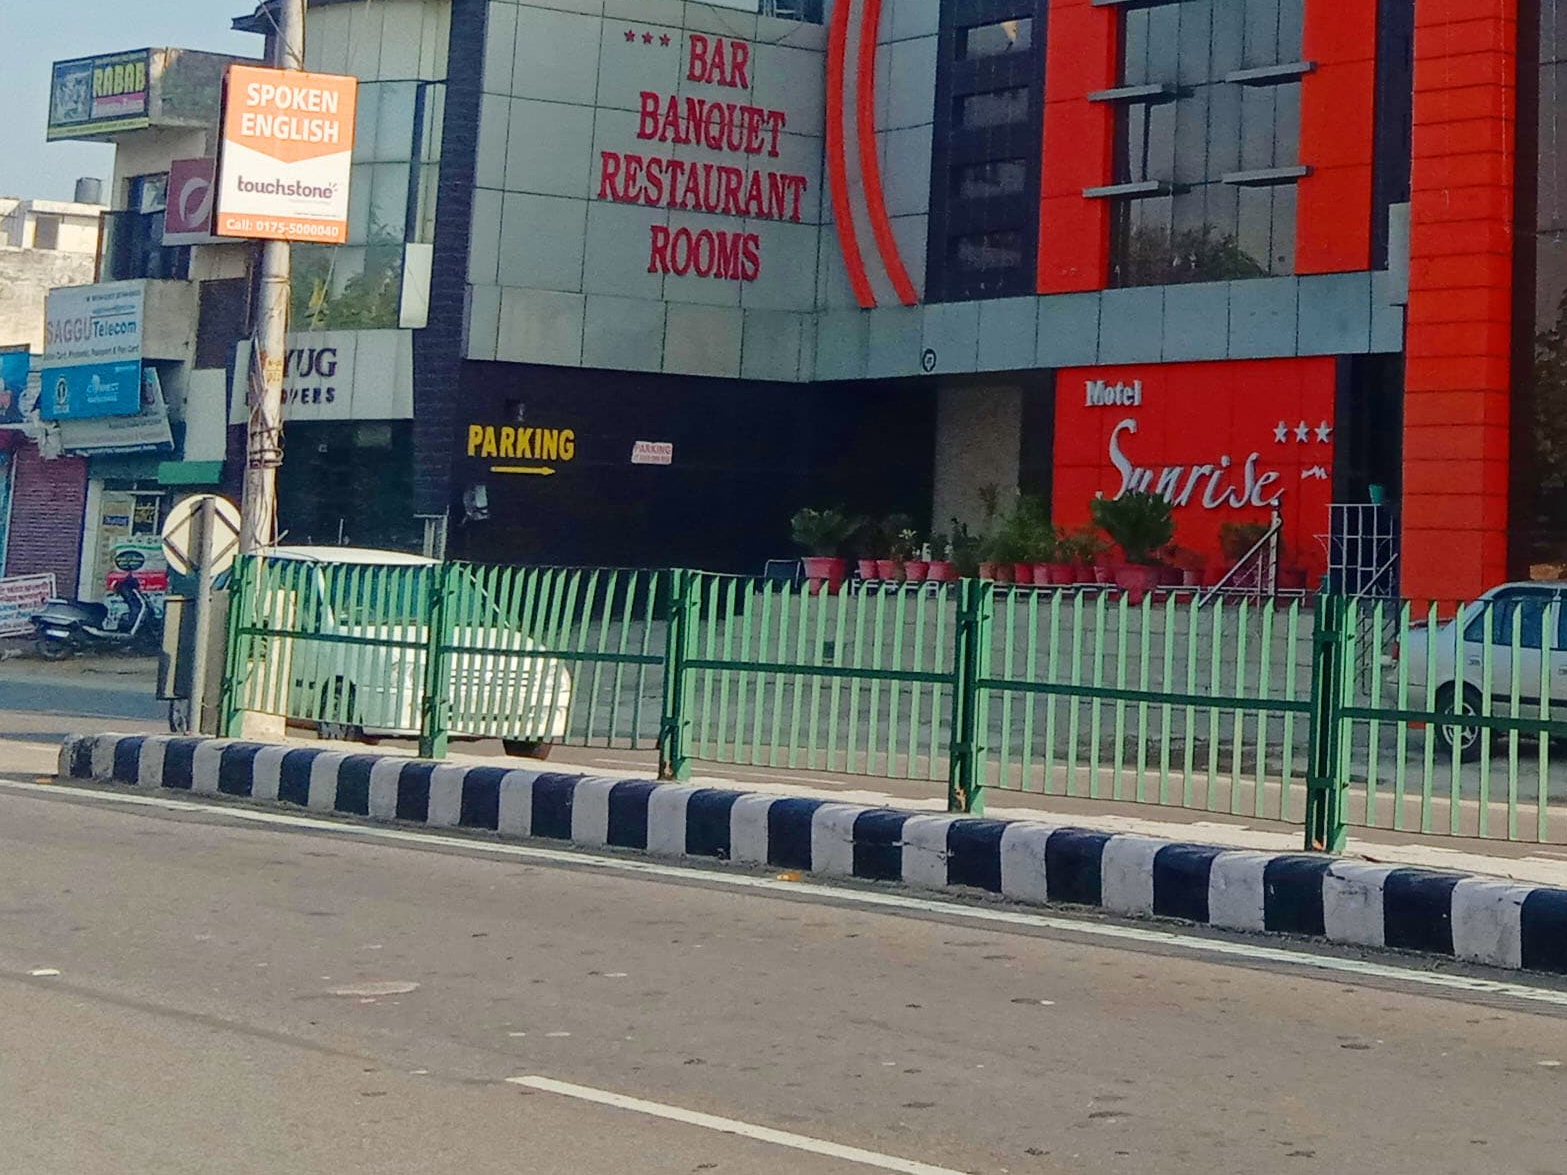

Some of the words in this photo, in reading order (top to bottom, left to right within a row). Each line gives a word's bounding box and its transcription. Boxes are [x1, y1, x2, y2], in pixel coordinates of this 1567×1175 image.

[687, 34, 749, 89] BAR
[94, 62, 145, 96] RABAB
[246, 83, 338, 114] SPOKEN
[241, 113, 339, 143] ENGLISH
[637, 91, 786, 158] BANQUET
[237, 175, 334, 199] touchstone
[598, 151, 808, 223] RESTAURANT
[226, 218, 252, 231] Call:
[255, 221, 340, 238] 0175-5000040
[647, 225, 761, 282] ROOMS
[93, 320, 138, 338] Telecom
[1084, 379, 1143, 407] Motel
[467, 424, 575, 462] PARKING
[1096, 417, 1286, 510] Sunrise
